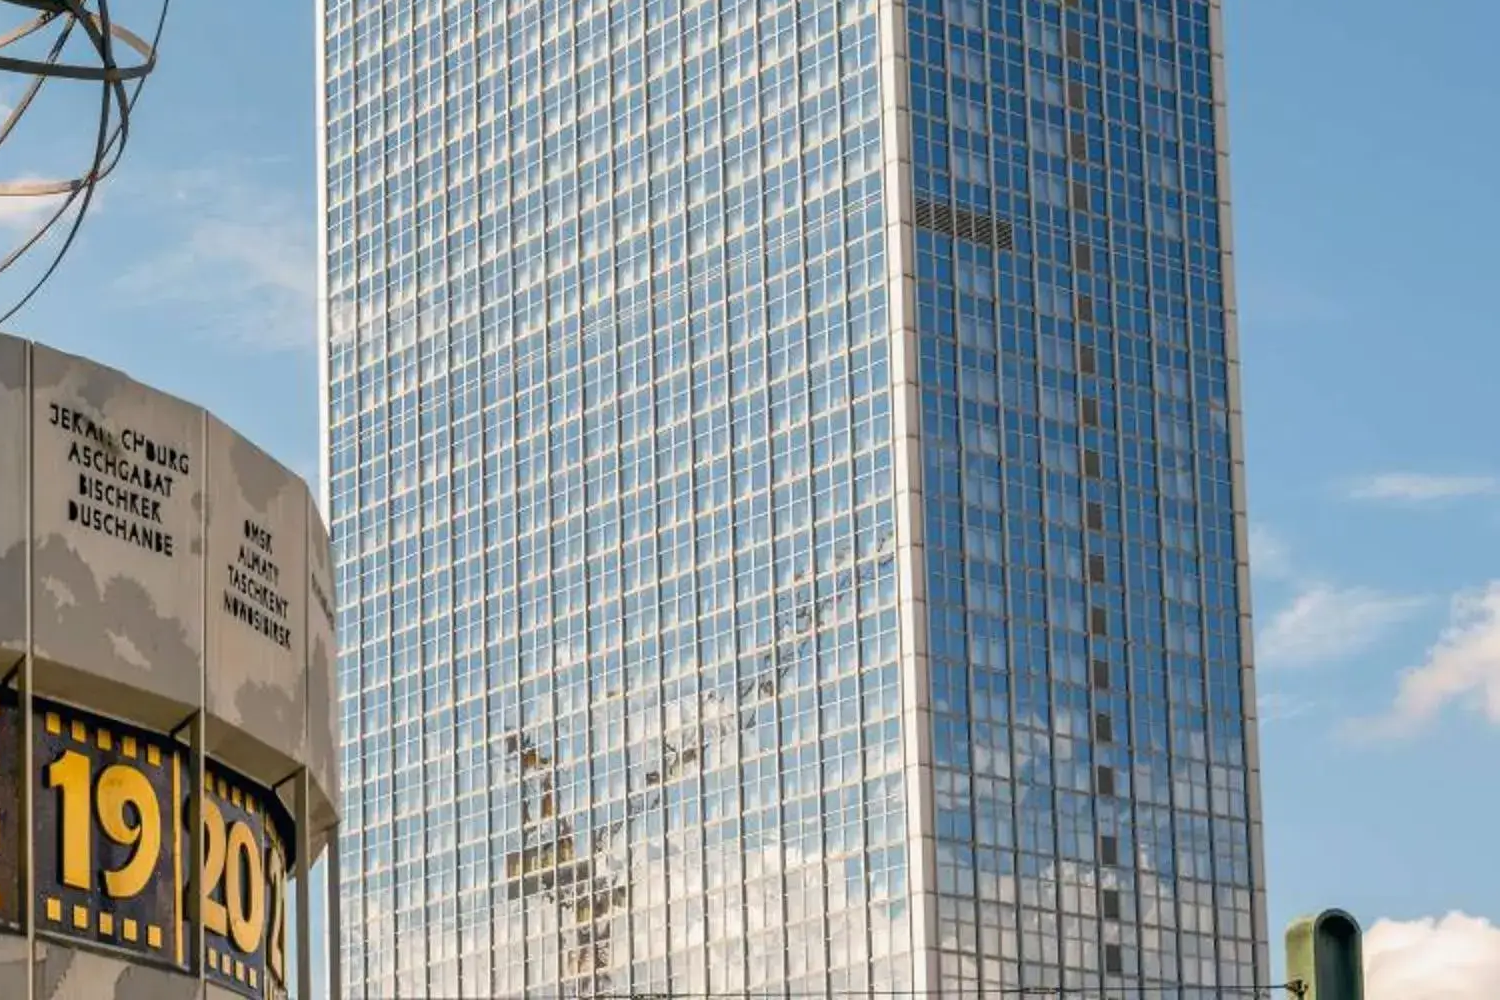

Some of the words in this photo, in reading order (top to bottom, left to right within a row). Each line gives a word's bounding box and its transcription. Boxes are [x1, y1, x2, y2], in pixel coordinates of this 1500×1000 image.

[67, 441, 173, 497] ASCHGABAT
[79, 473, 161, 524] BISCHKEK
[68, 499, 173, 557] DUSCHANBE
[48, 749, 161, 898] 19
[202, 799, 264, 953] 20
